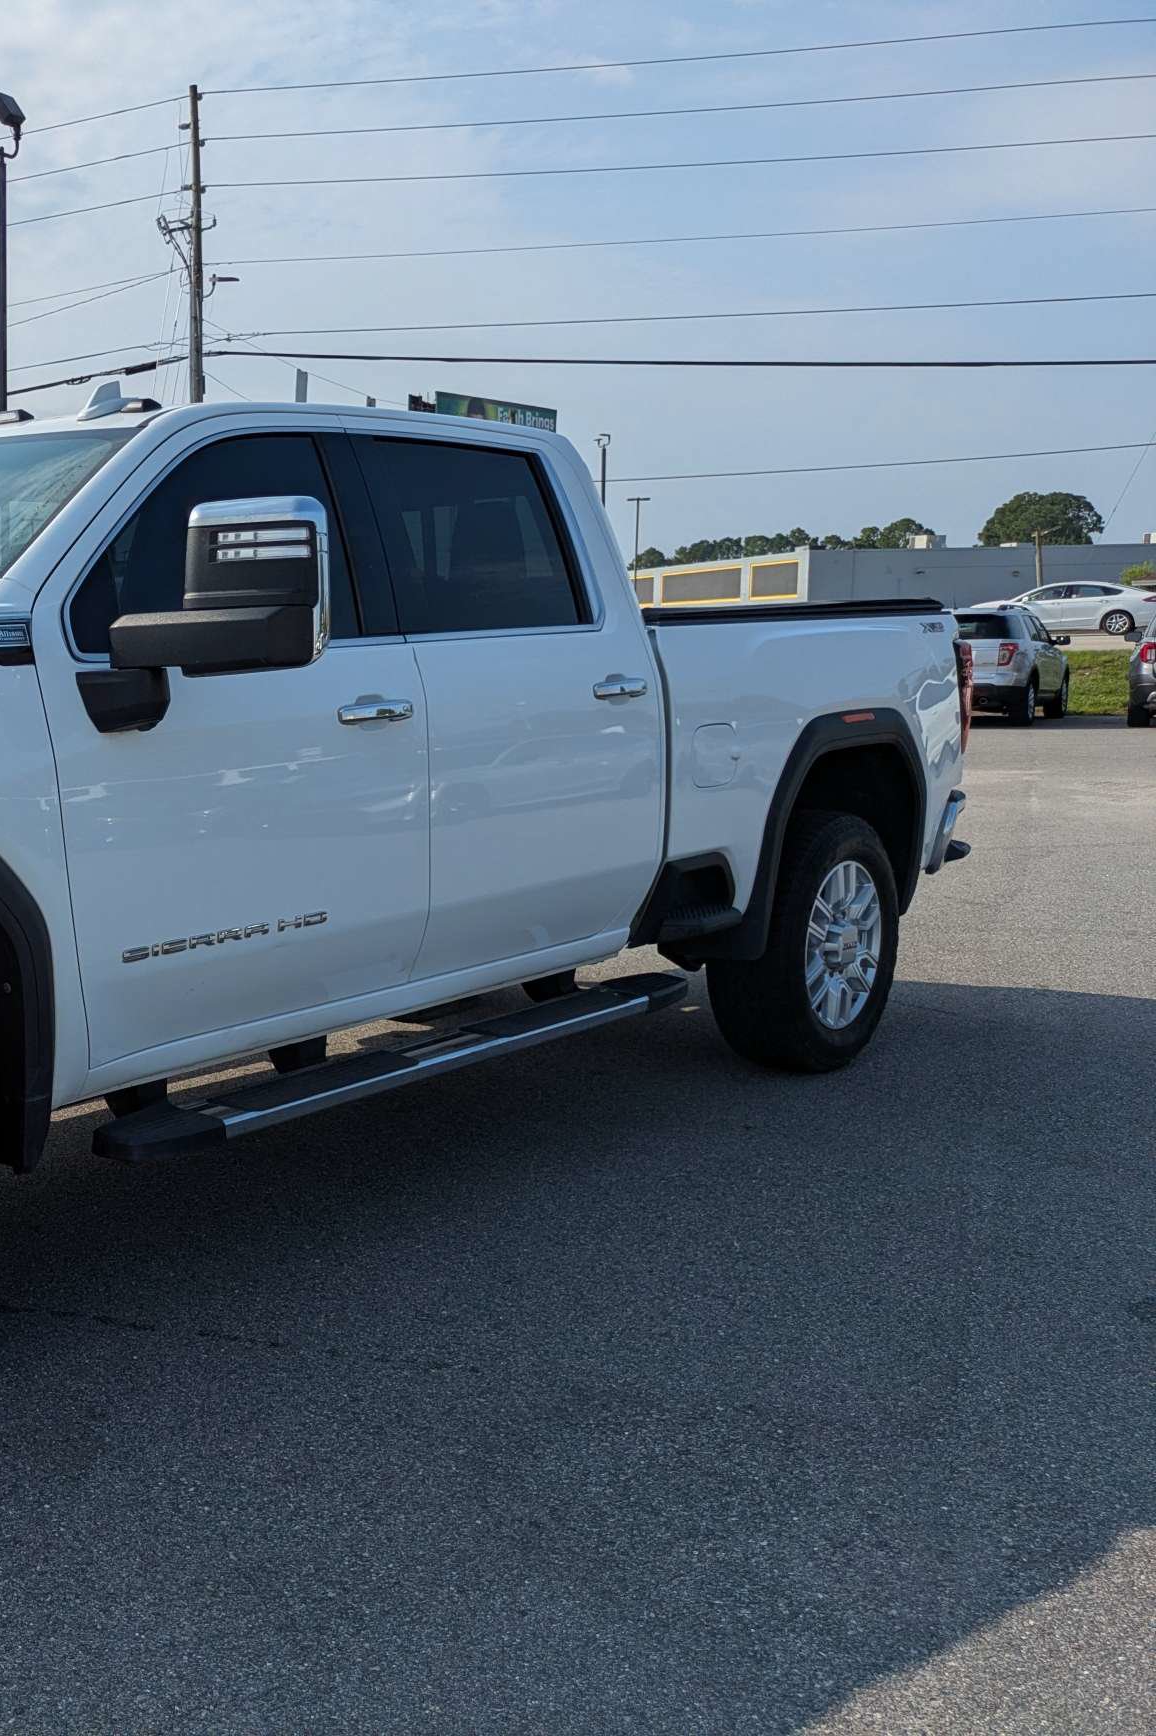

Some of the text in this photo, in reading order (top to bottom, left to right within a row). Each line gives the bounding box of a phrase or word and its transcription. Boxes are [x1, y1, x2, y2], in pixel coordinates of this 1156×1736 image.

[526, 410, 555, 431] Brings
[122, 911, 328, 963] SIERRA HD
